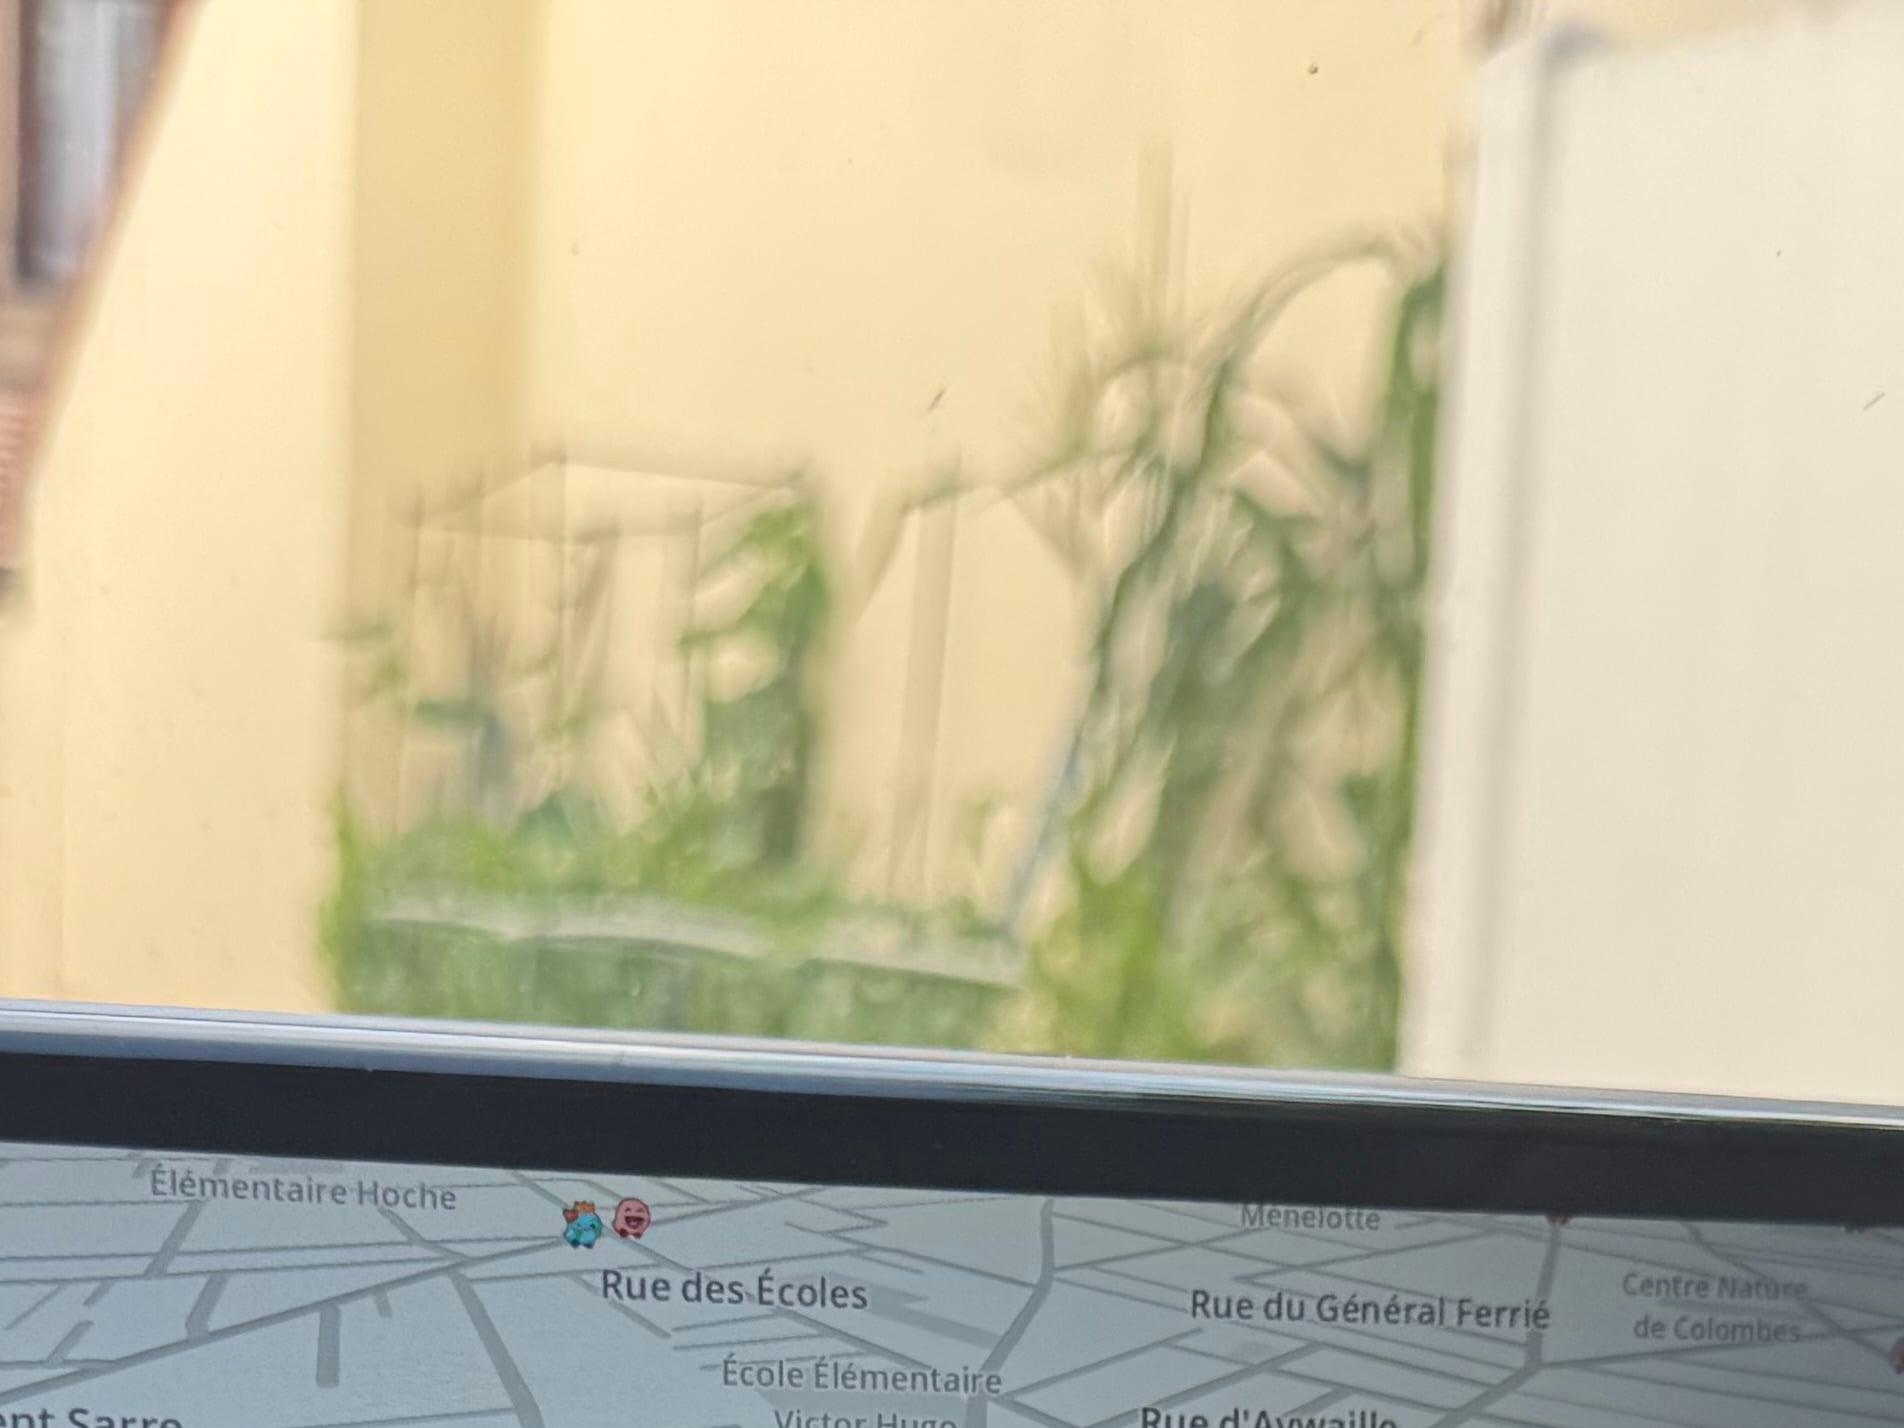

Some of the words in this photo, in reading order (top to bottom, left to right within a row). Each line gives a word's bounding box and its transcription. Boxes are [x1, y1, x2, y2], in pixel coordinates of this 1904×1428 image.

[150, 1166, 347, 1206] Élémentaire
[357, 1182, 458, 1211] Hoche
[601, 1270, 670, 1302] Rue
[681, 1272, 743, 1305] des
[757, 1266, 868, 1310] Écoles
[1622, 1273, 1709, 1299] Centre
[1191, 1290, 1254, 1322] Rue
[1263, 1291, 1306, 1322] du
[1316, 1293, 1444, 1326] Général
[1457, 1297, 1550, 1330] Ferrié
[1634, 1314, 1667, 1341] de
[1674, 1315, 1801, 1343] Colombes
[723, 1358, 805, 1388] École
[814, 1358, 1003, 1396] Élémentaire
